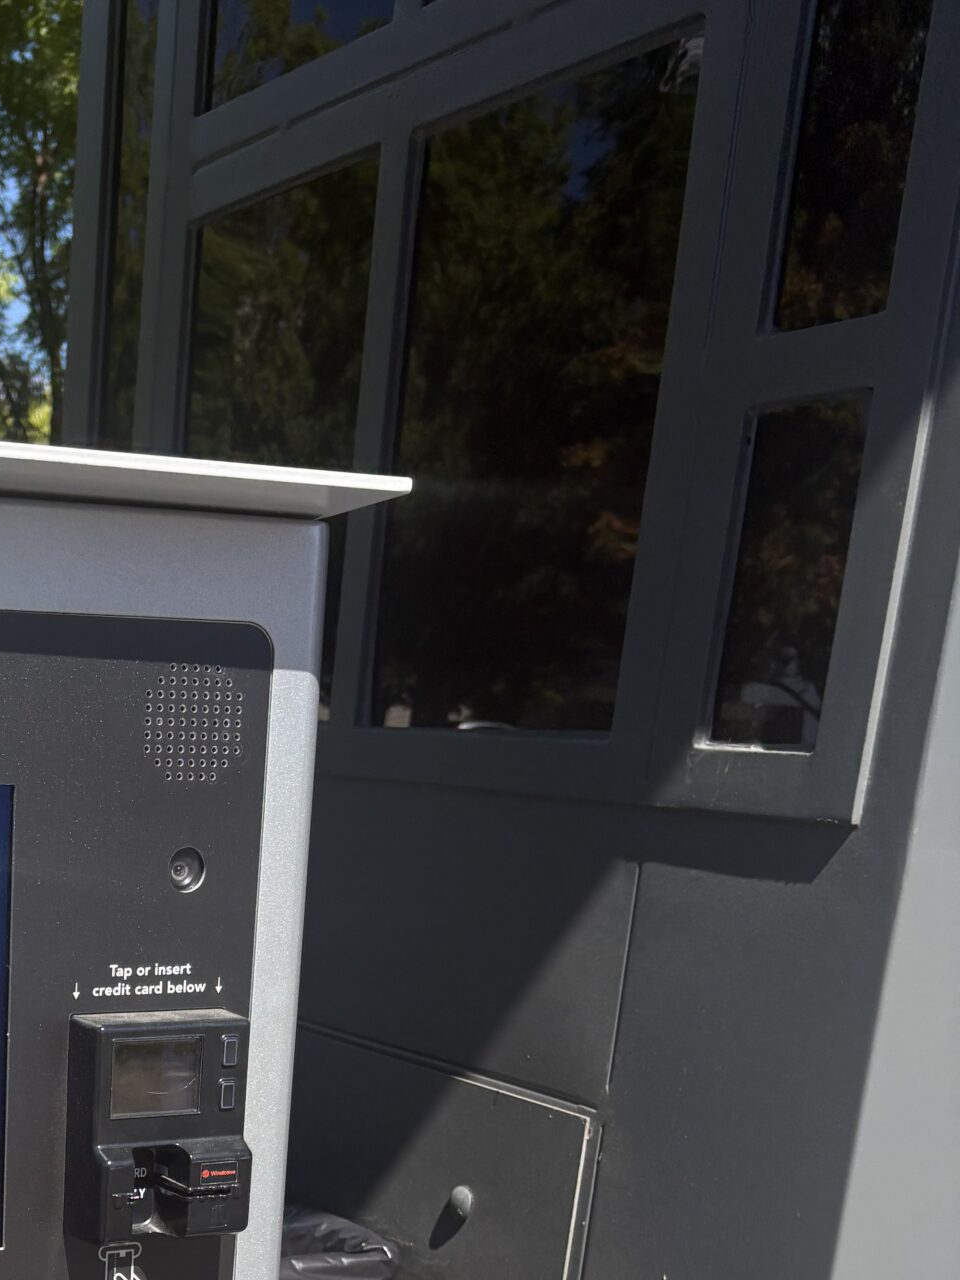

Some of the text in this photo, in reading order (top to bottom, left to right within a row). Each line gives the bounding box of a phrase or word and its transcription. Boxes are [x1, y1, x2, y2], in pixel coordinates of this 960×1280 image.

[109, 962, 192, 980] Tap or insert
[92, 979, 207, 997] credit card below
[134, 1167, 147, 1178] RD
